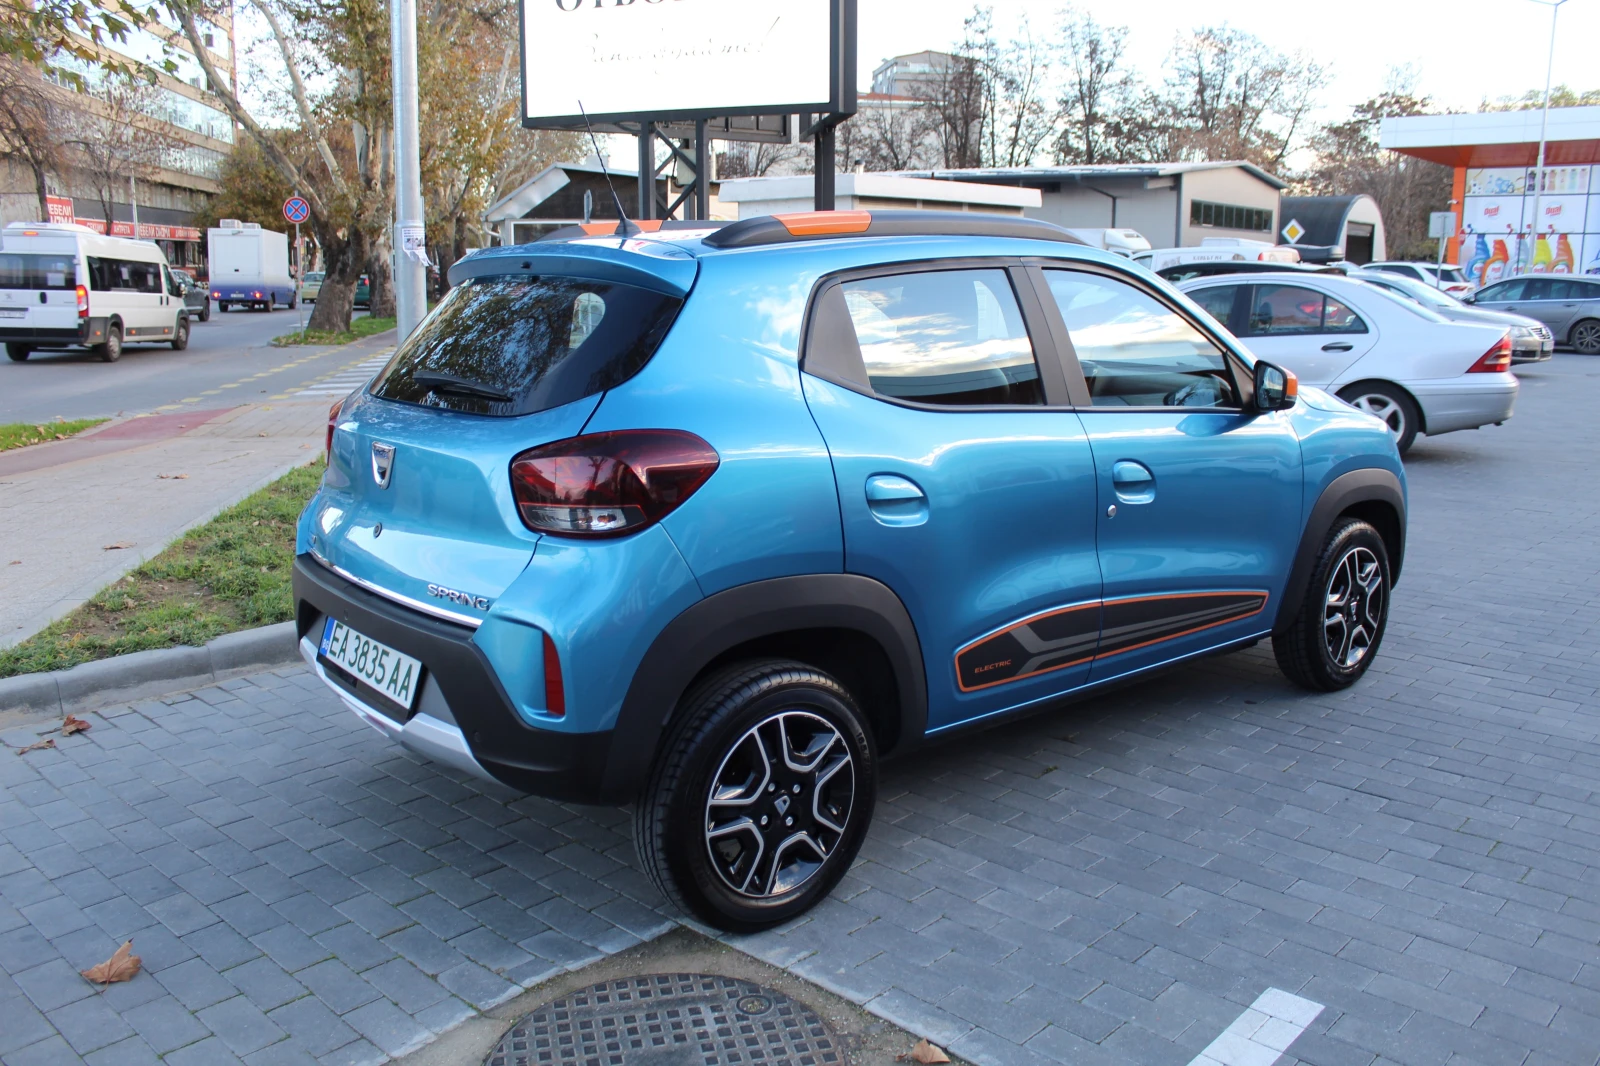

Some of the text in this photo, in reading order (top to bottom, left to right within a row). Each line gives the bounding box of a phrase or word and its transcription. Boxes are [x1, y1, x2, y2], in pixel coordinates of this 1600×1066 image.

[427, 584, 489, 610] SPRING
[328, 622, 413, 702] EA 3835 AA
[974, 659, 1011, 673] ELECTRIC
